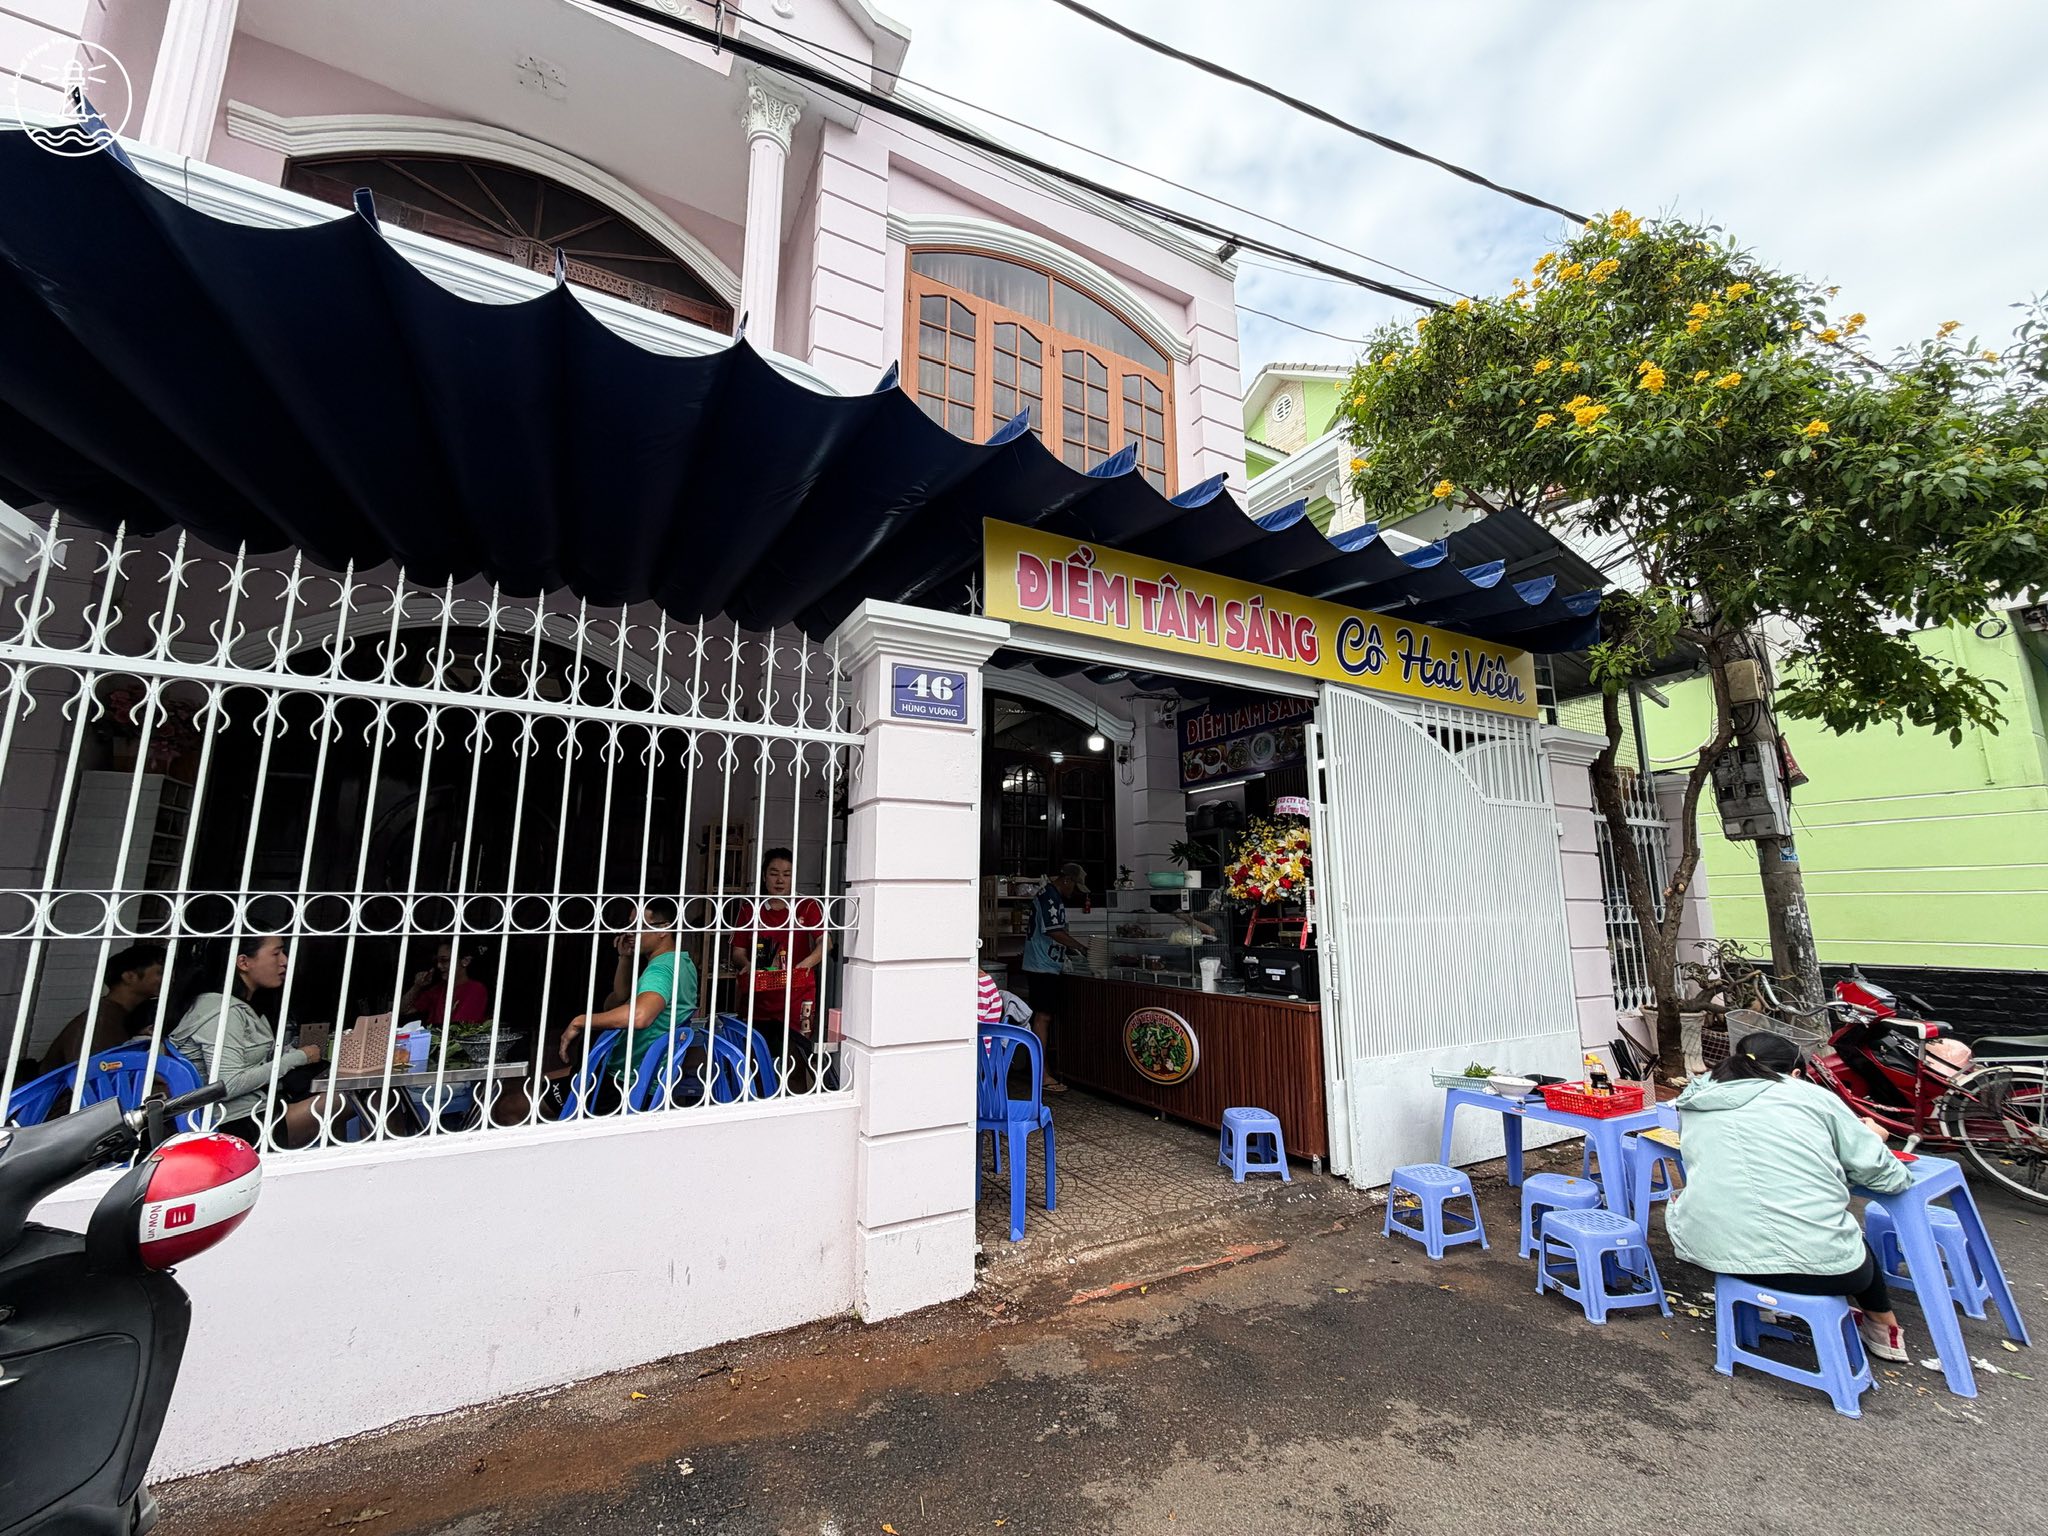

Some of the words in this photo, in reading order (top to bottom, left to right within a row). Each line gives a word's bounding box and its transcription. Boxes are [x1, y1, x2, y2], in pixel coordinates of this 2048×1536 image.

[1016, 544, 1130, 629] ĐIỂM
[1132, 573, 1219, 647] TÂM
[1224, 594, 1320, 666] SÁNG
[1336, 616, 1388, 675] Cô
[1396, 627, 1463, 690] Hai
[1464, 648, 1526, 703] Viên
[907, 673, 954, 701] 46
[902, 703, 926, 713] HÙNG
[928, 706, 958, 717] VƯƠNG
